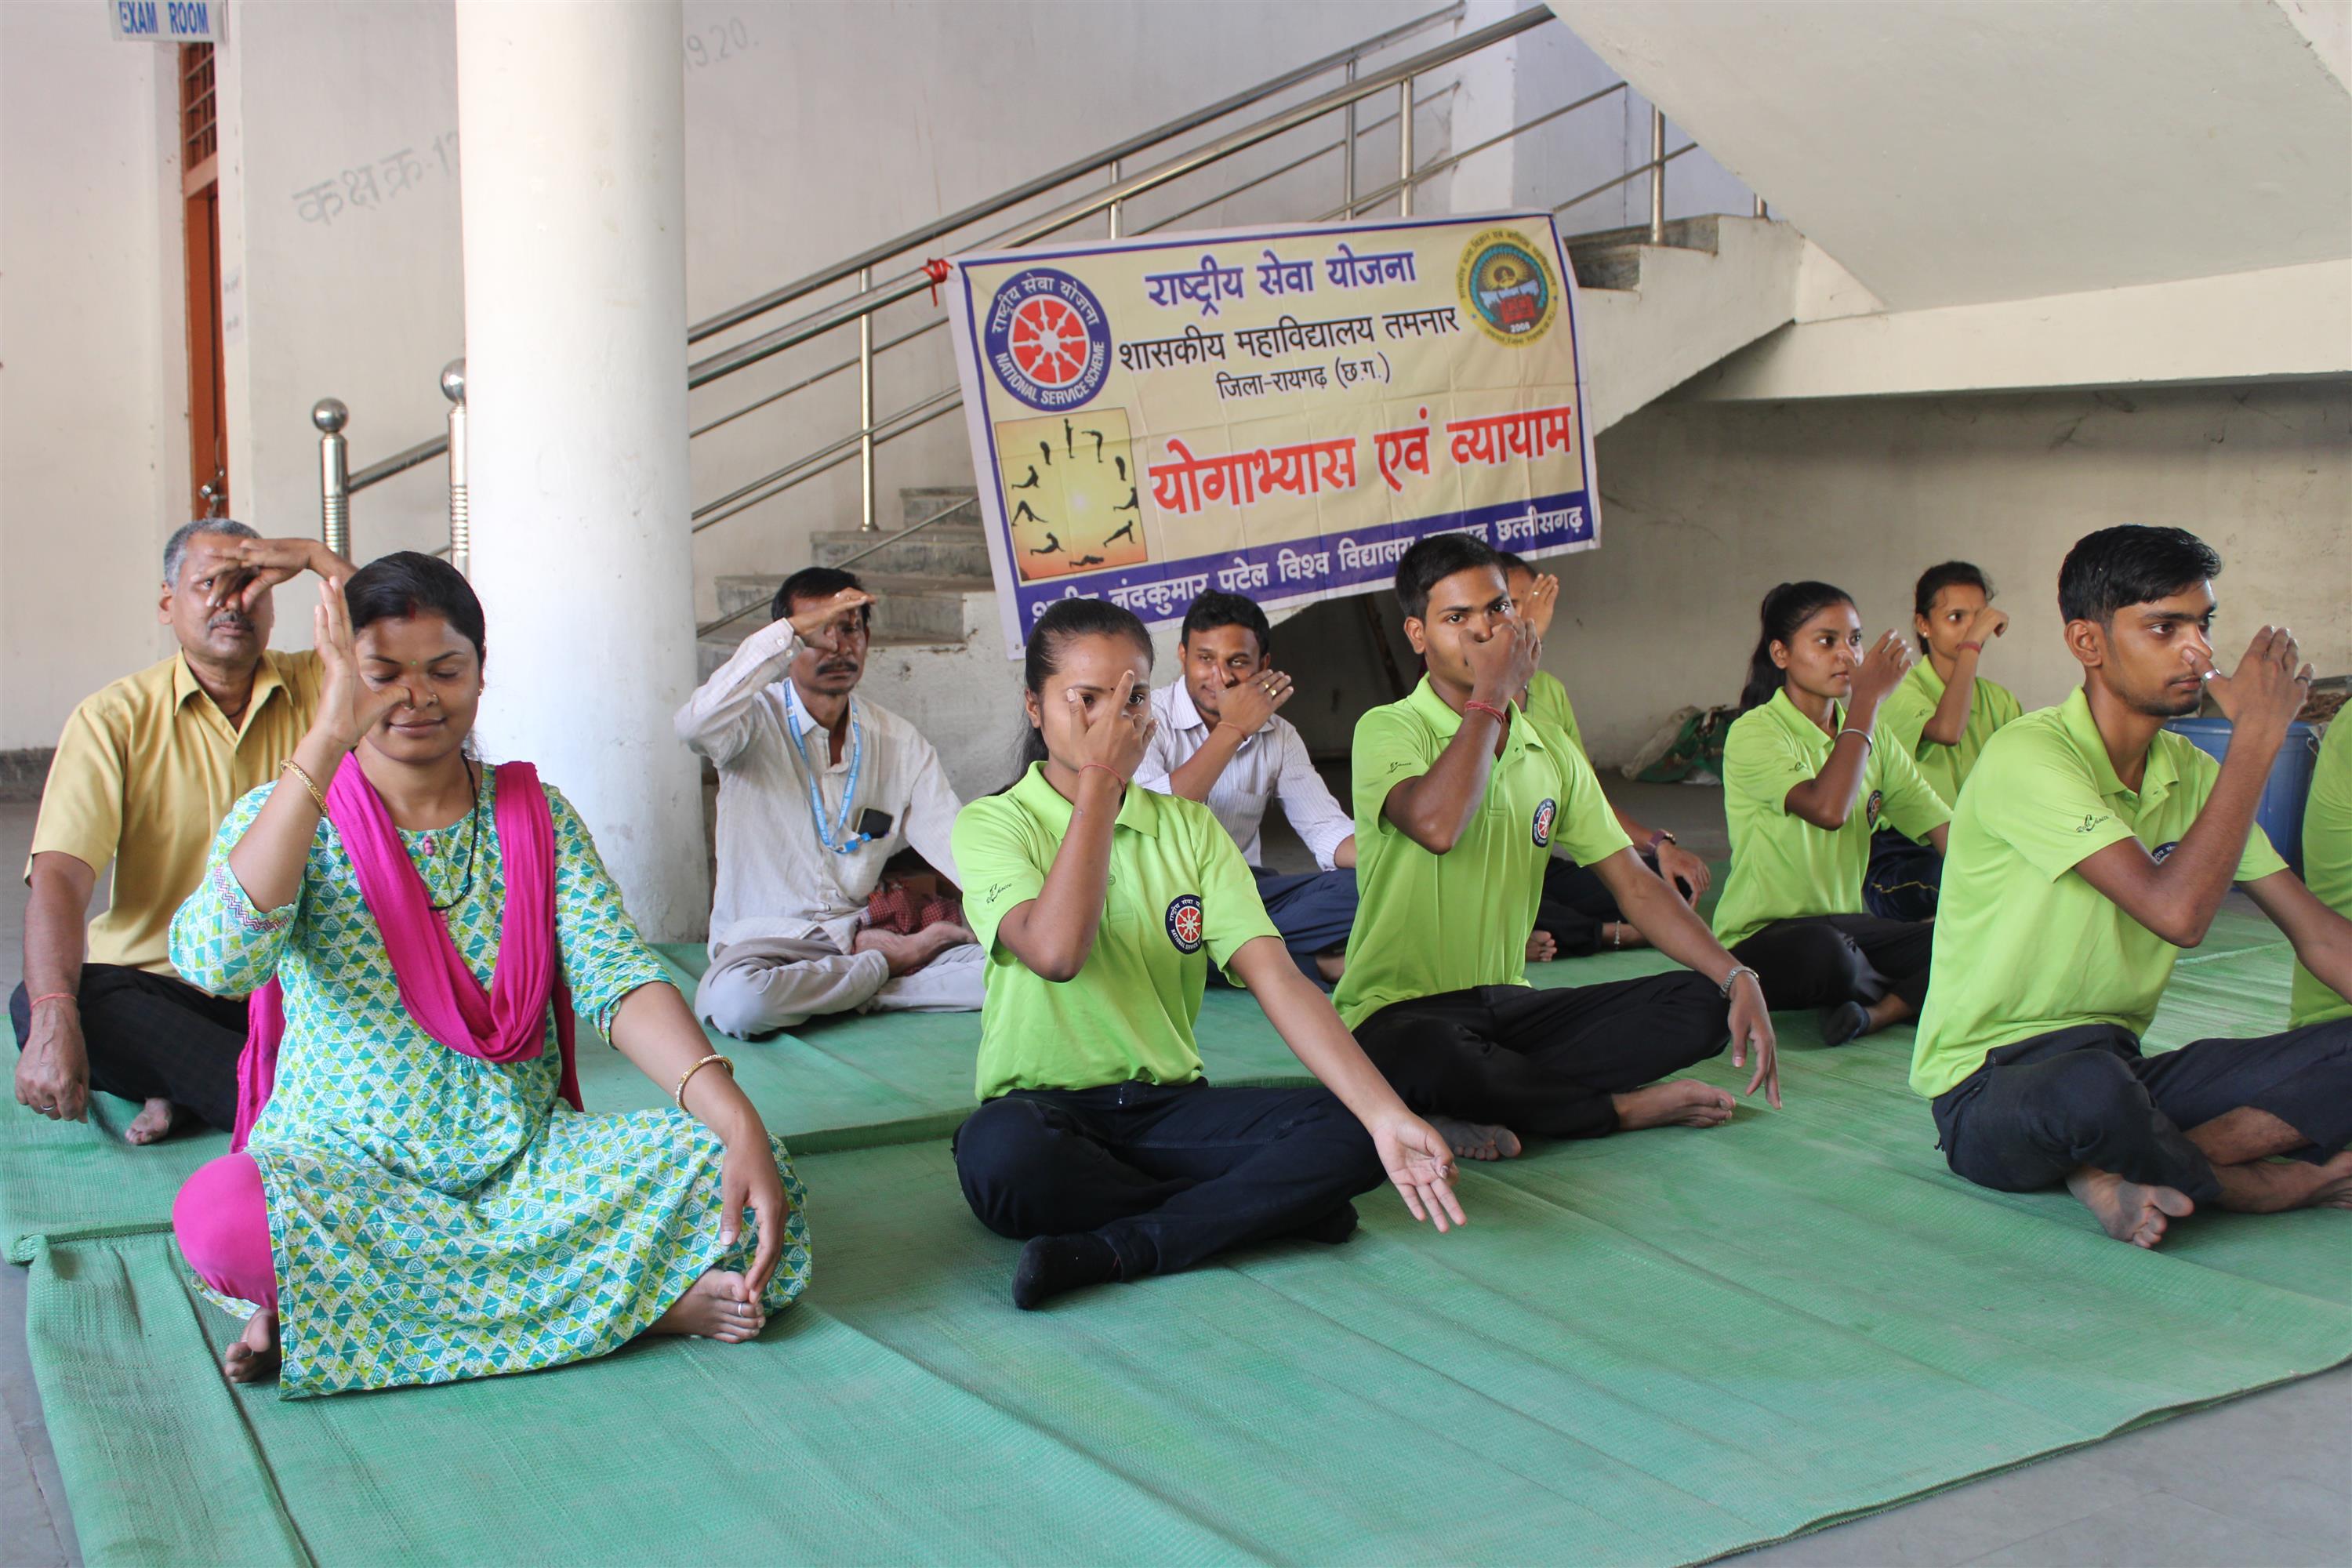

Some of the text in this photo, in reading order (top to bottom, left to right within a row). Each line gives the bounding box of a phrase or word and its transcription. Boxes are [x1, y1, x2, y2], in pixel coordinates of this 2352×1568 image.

[119, 2, 209, 34] EXAM ROOM
[992, 273, 1100, 333] राष्ट्रीय सेवा योजना
[1145, 243, 1416, 315] राष्ट्रीय सेवा योजना
[1119, 306, 1460, 371] शासकीय महाविद्यालय तमनार
[995, 341, 1105, 405] NATIONAL SERVICE SCHEME
[1149, 406, 1571, 514] योगाभ्यास एवं व्यायाम
[1218, 557, 1269, 592] पटेल
[1277, 549, 1330, 583] विश्व
[1496, 506, 1584, 543] छत्तीसगढ़
